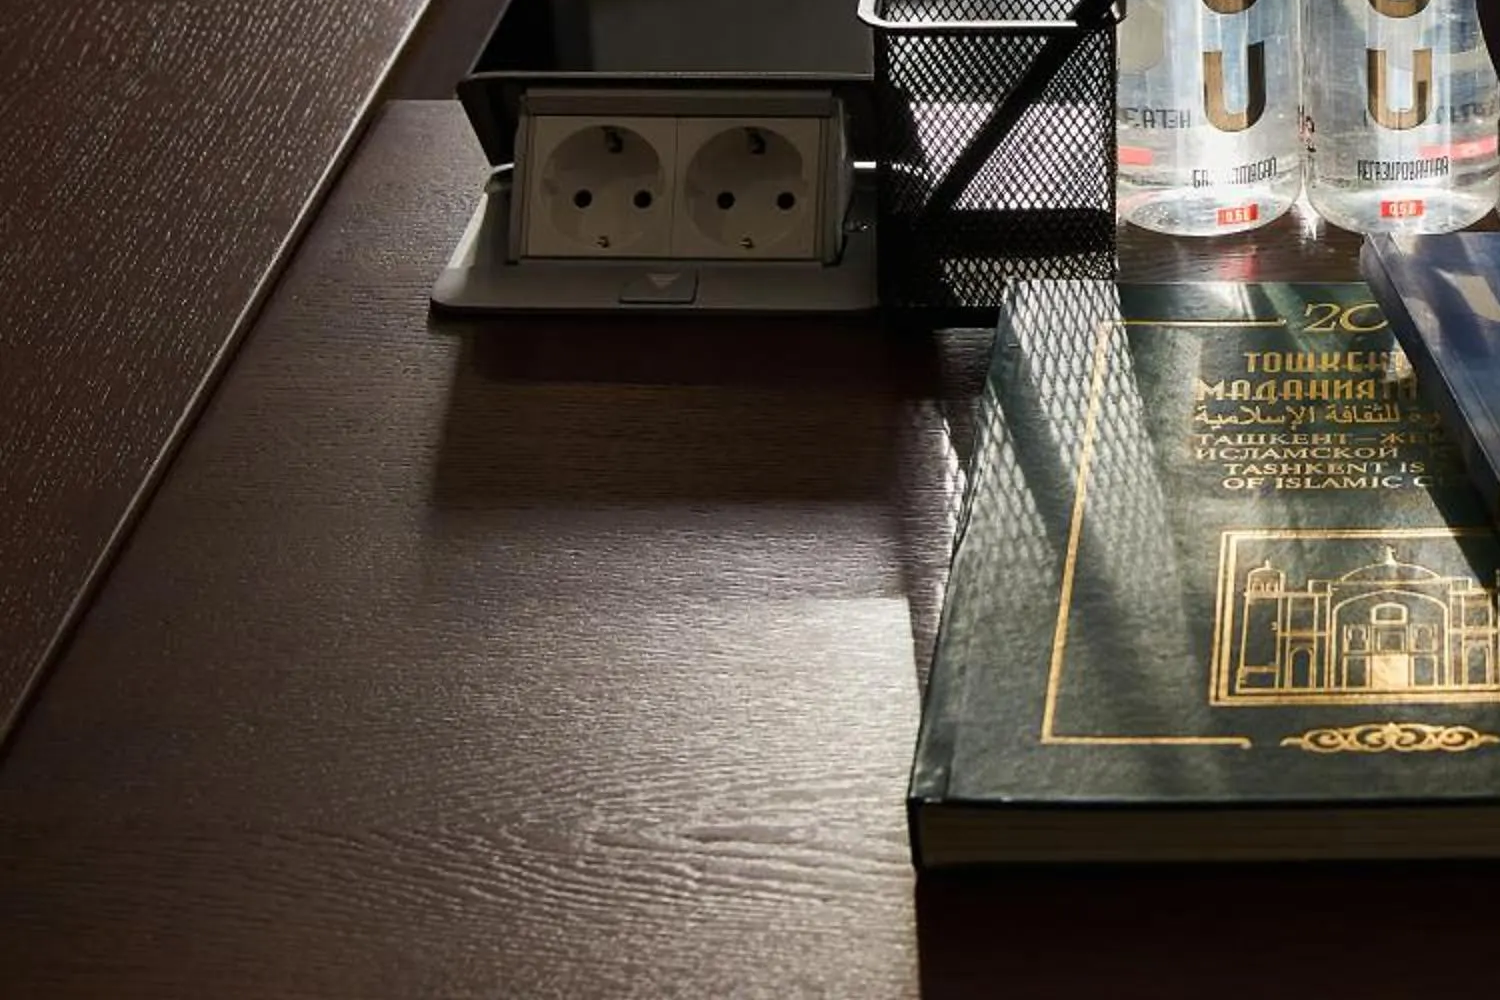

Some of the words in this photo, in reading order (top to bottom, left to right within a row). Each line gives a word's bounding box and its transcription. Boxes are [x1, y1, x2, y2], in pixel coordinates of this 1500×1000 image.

[1196, 446, 1398, 460] ИСЛАМСКОЙ
[1223, 463, 1389, 475] TASHKENT
[1222, 476, 1266, 489] OF
[1275, 475, 1403, 489] ISLAMIC
